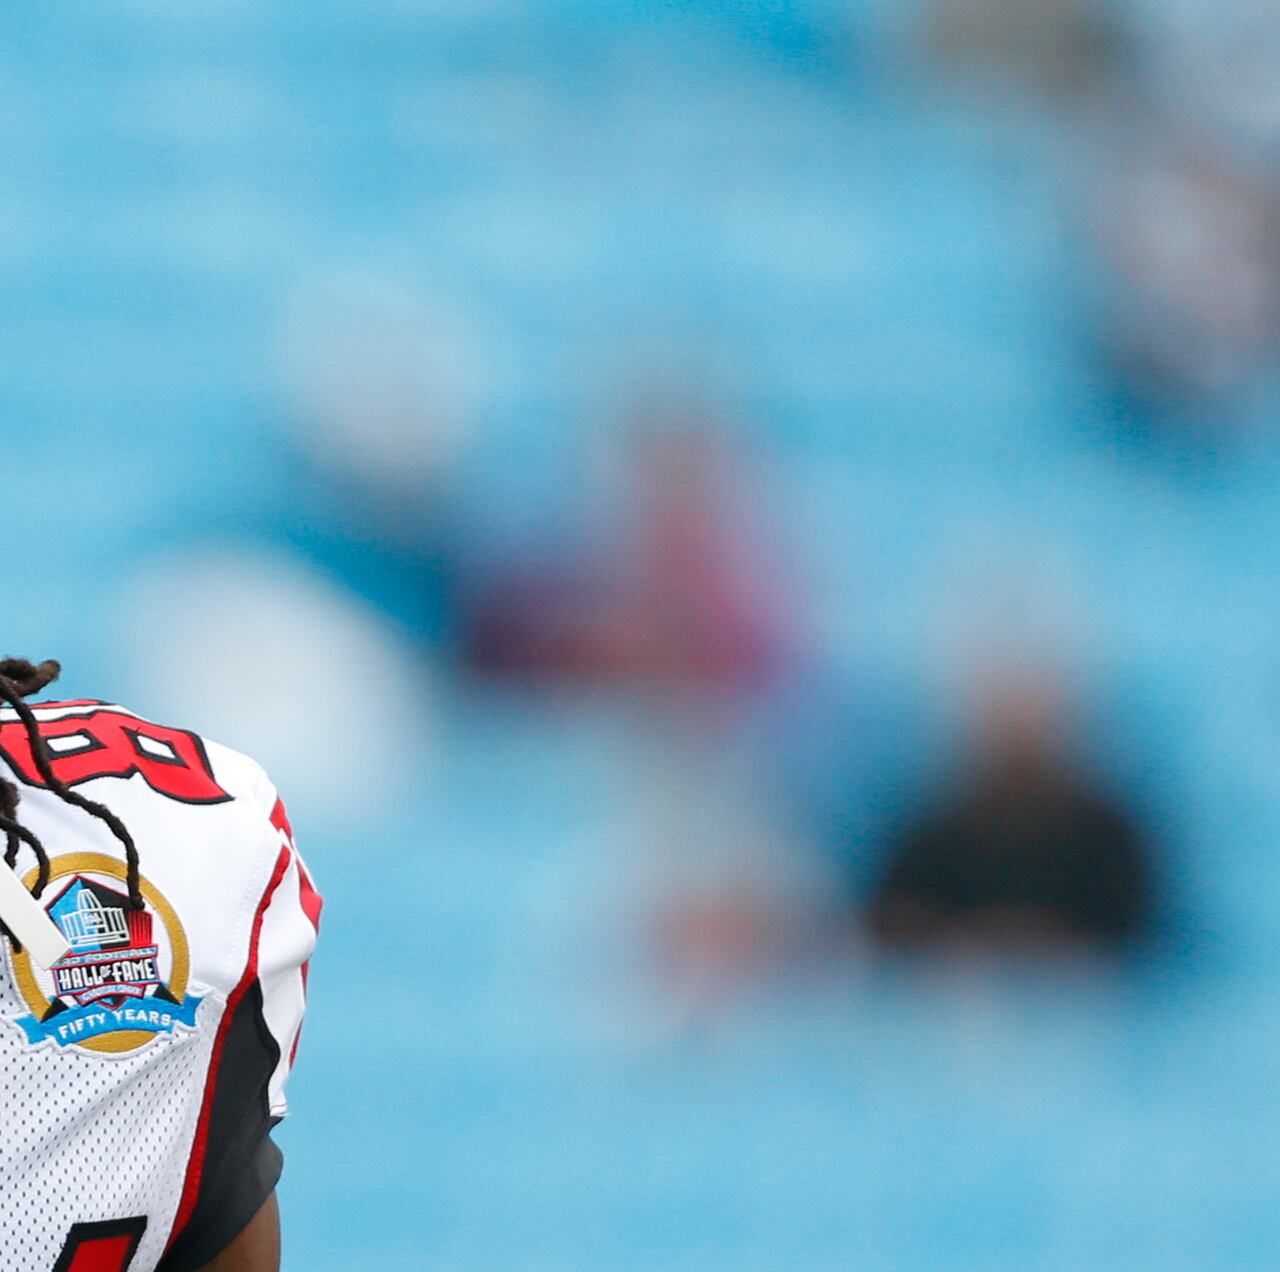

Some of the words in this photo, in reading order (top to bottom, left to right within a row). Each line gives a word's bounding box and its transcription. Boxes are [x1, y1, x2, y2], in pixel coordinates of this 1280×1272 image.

[59, 965, 104, 990] HALL
[111, 958, 156, 983] FAME
[57, 1012, 107, 1039] FIFTY
[112, 1008, 172, 1027] YEARS
